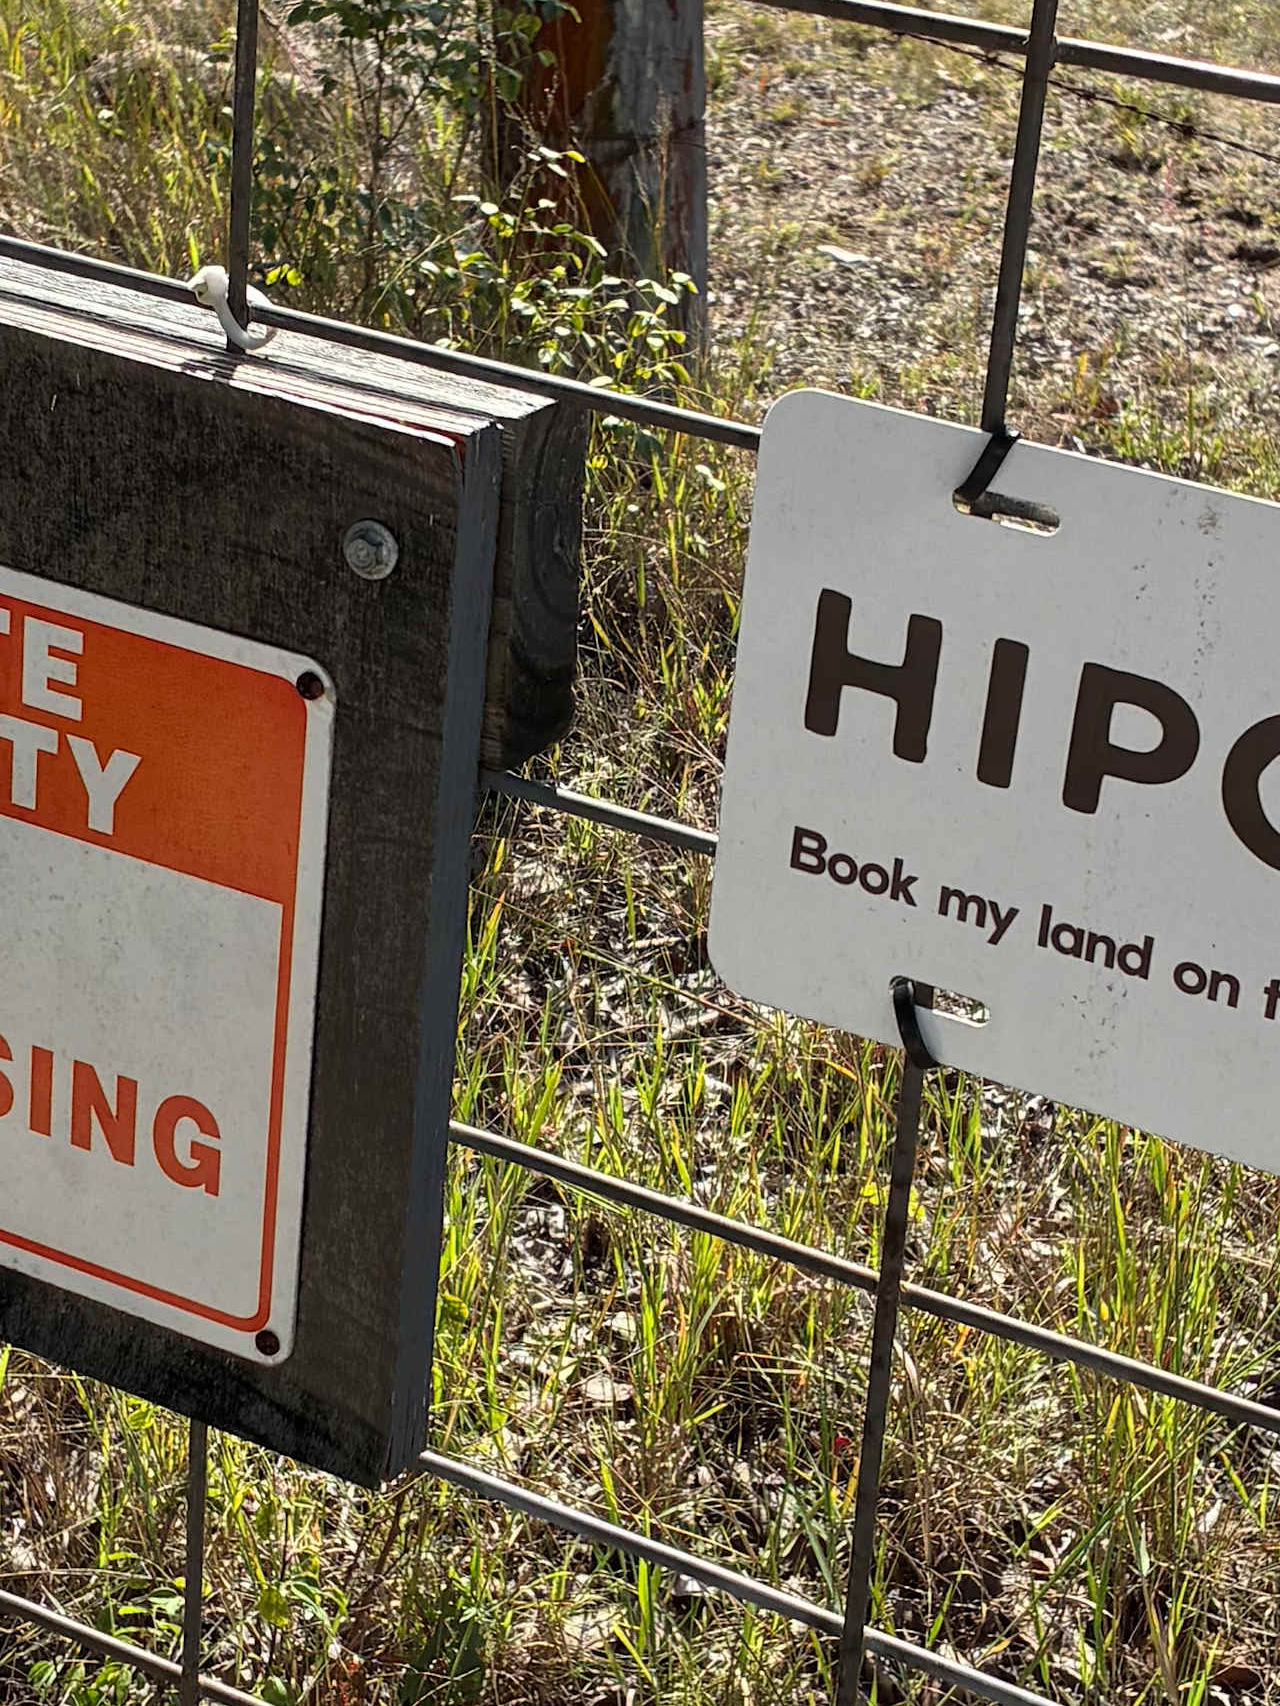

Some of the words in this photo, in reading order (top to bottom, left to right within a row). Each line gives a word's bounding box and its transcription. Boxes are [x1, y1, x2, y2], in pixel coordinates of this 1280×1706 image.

[789, 825, 919, 908] Book
[937, 885, 1020, 946] my
[1037, 903, 1155, 981] land
[1173, 961, 1241, 1009] on
